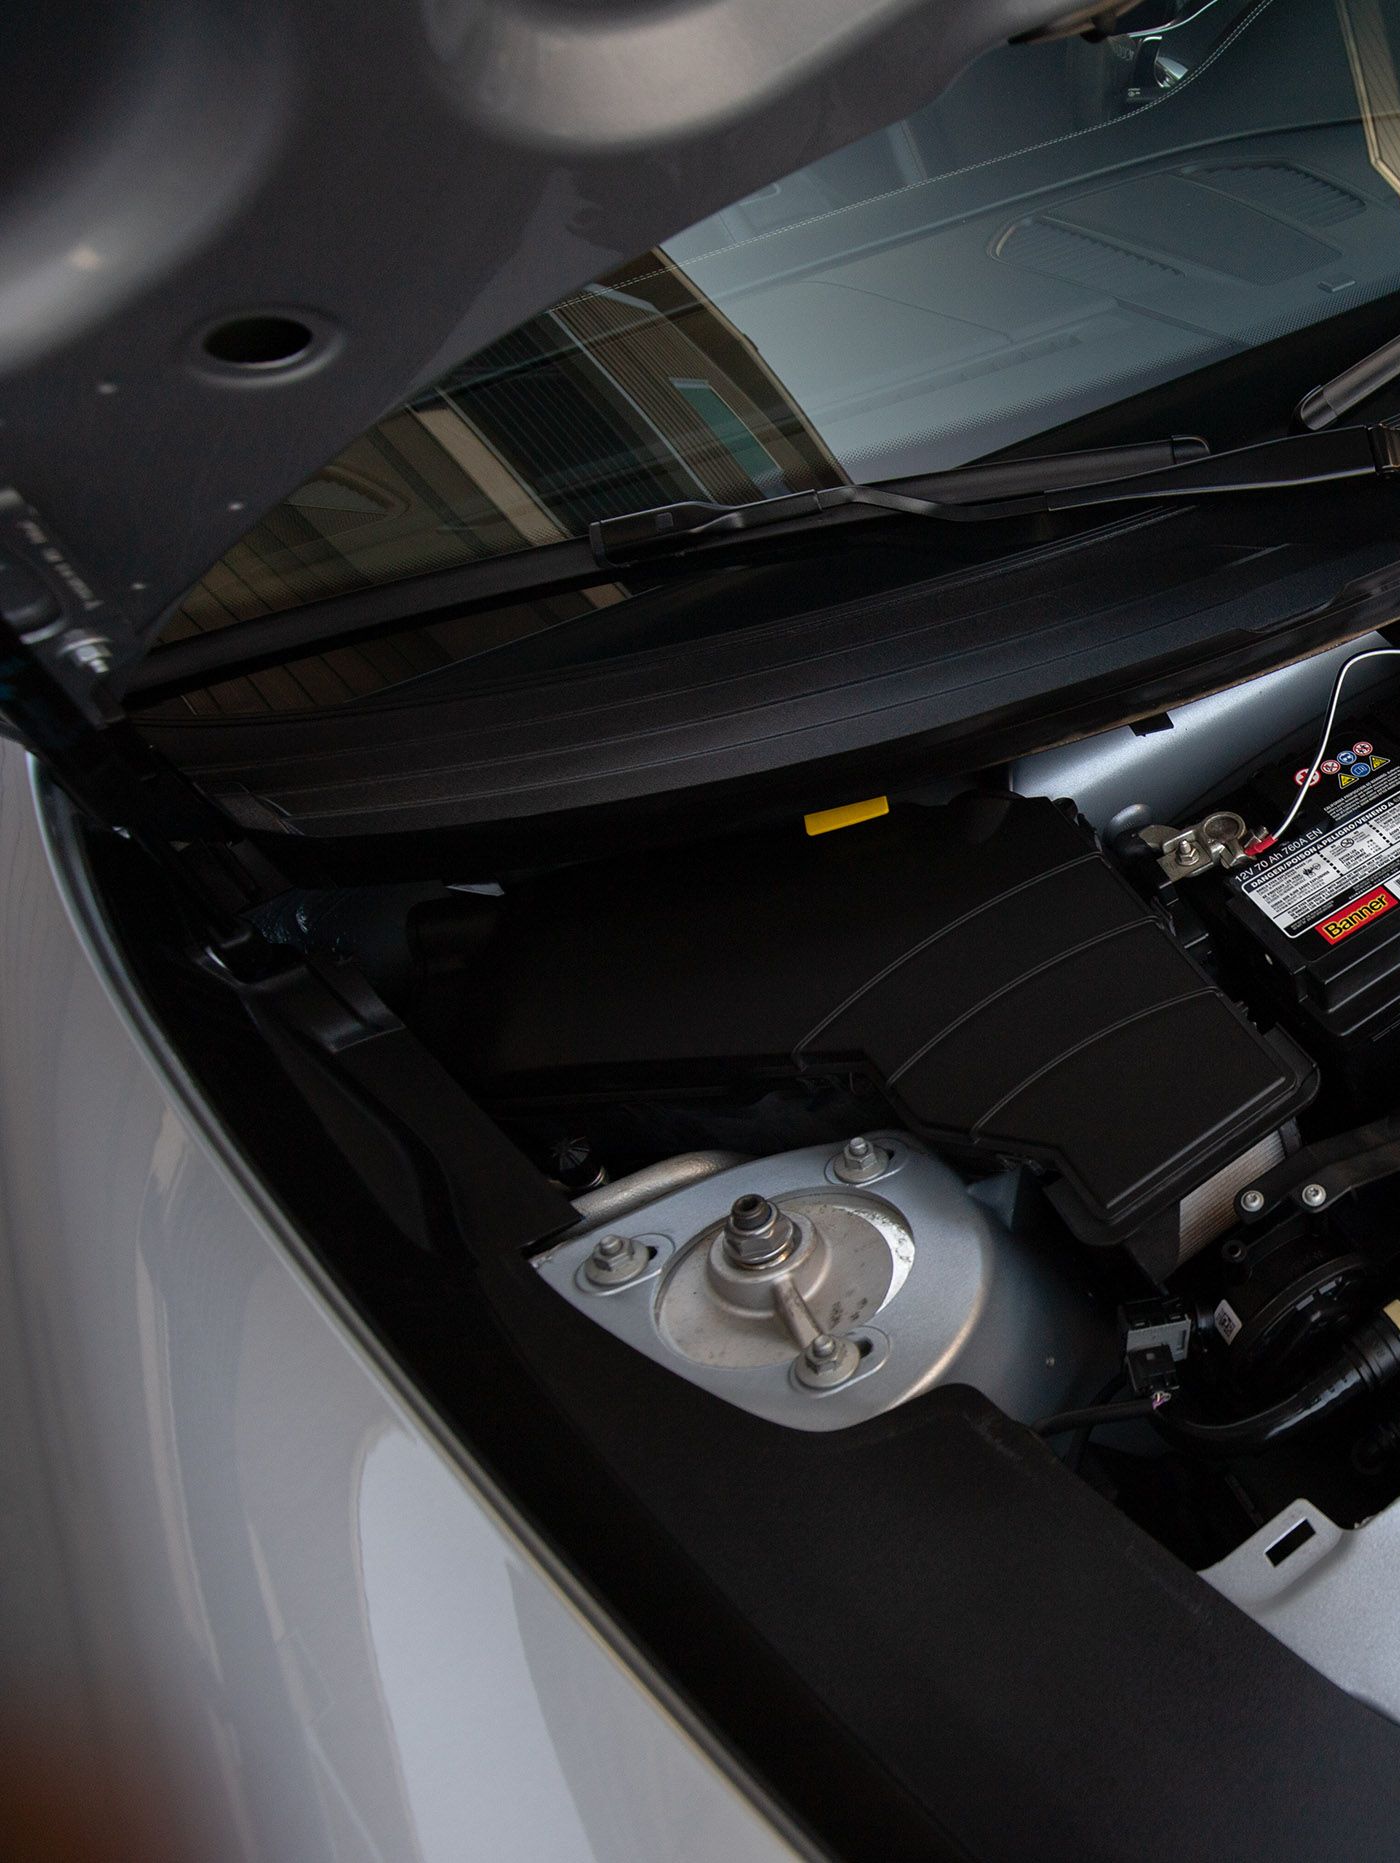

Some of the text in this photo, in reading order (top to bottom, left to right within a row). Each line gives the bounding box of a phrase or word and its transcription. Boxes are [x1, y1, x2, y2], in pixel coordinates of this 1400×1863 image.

[1234, 828, 1323, 882] 12V 70 Ah 760A EN
[1323, 893, 1388, 939] Banner
